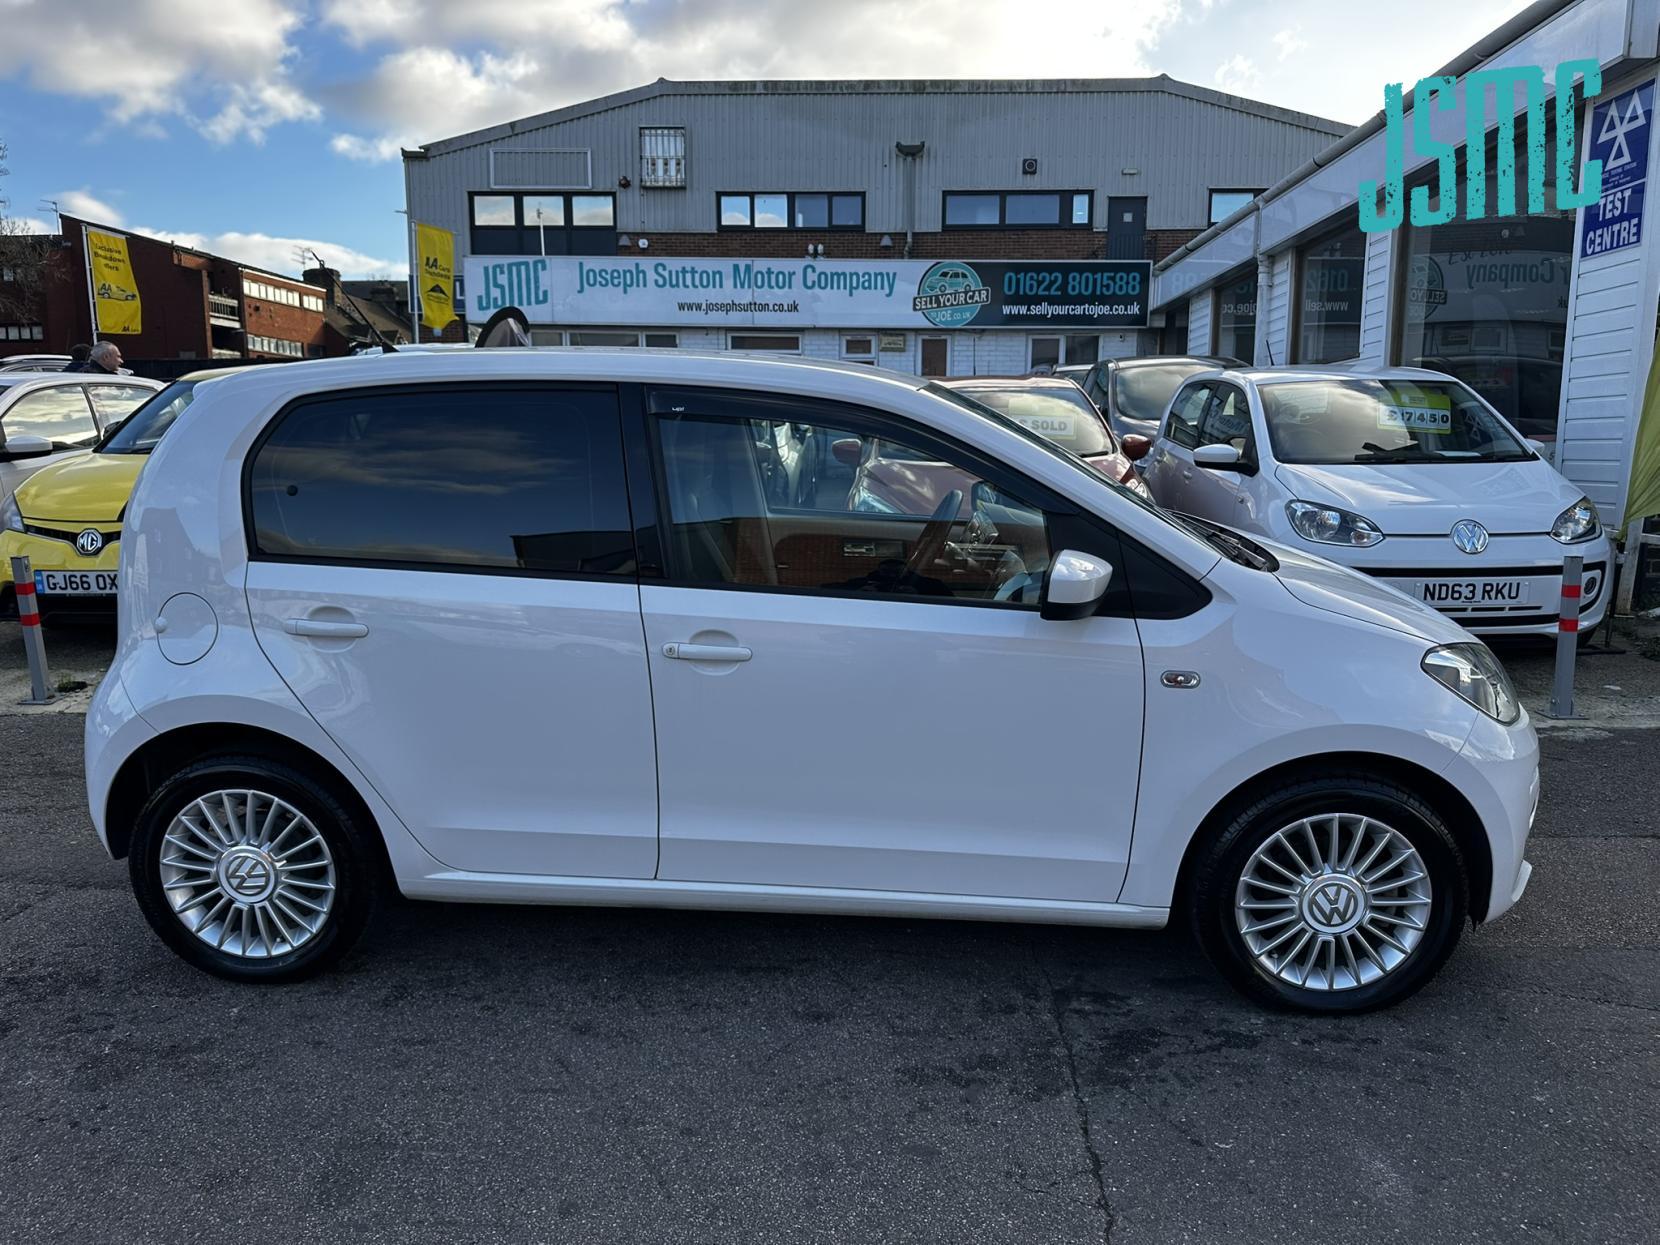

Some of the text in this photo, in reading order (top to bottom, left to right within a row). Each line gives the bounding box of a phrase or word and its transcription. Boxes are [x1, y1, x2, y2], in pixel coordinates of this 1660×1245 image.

[1598, 188, 1632, 223] TEST
[1586, 217, 1639, 255] CENTRE
[100, 283, 112, 292] AA
[477, 259, 549, 311] JSMC
[577, 261, 897, 297] Joseph Sutton Motor Company
[1003, 272, 1062, 296] 01622
[1067, 271, 1141, 296] 801588
[678, 299, 799, 316] www.josephsutton.co.uk
[915, 290, 988, 310] SELL YOUR CAR
[1002, 303, 1141, 319] www.sellyourcartojoe.co.uk
[1031, 419, 1068, 431] SOLD
[78, 531, 98, 551] MG
[46, 574, 91, 591] GJ66
[95, 574, 118, 591] OX
[1423, 582, 1521, 601] ND63 RKU
